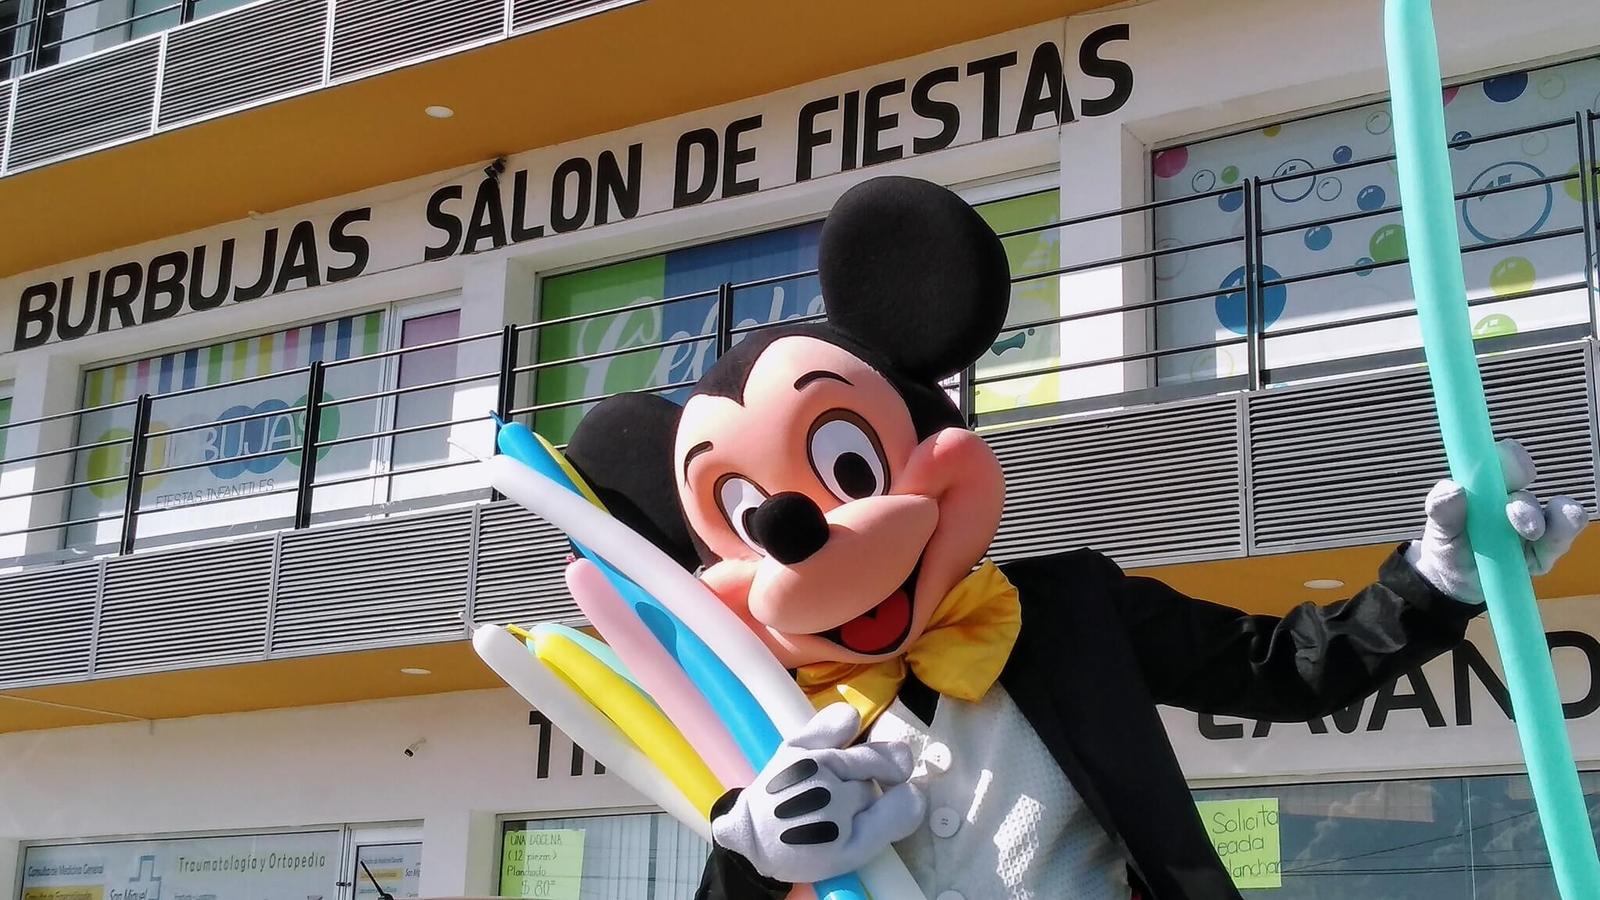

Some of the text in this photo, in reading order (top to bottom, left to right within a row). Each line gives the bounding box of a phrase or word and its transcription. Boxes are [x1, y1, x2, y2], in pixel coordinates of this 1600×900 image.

[14, 207, 370, 351] BURBUJAS
[673, 114, 762, 208] DE
[796, 23, 1135, 183] FIESTAS
[156, 489, 202, 507] FIESTAS
[1212, 804, 1279, 834] Solicita
[510, 834, 527, 846] UNA
[268, 852, 326, 870] Ortopedia
[1227, 858, 1281, 878] lanchar
